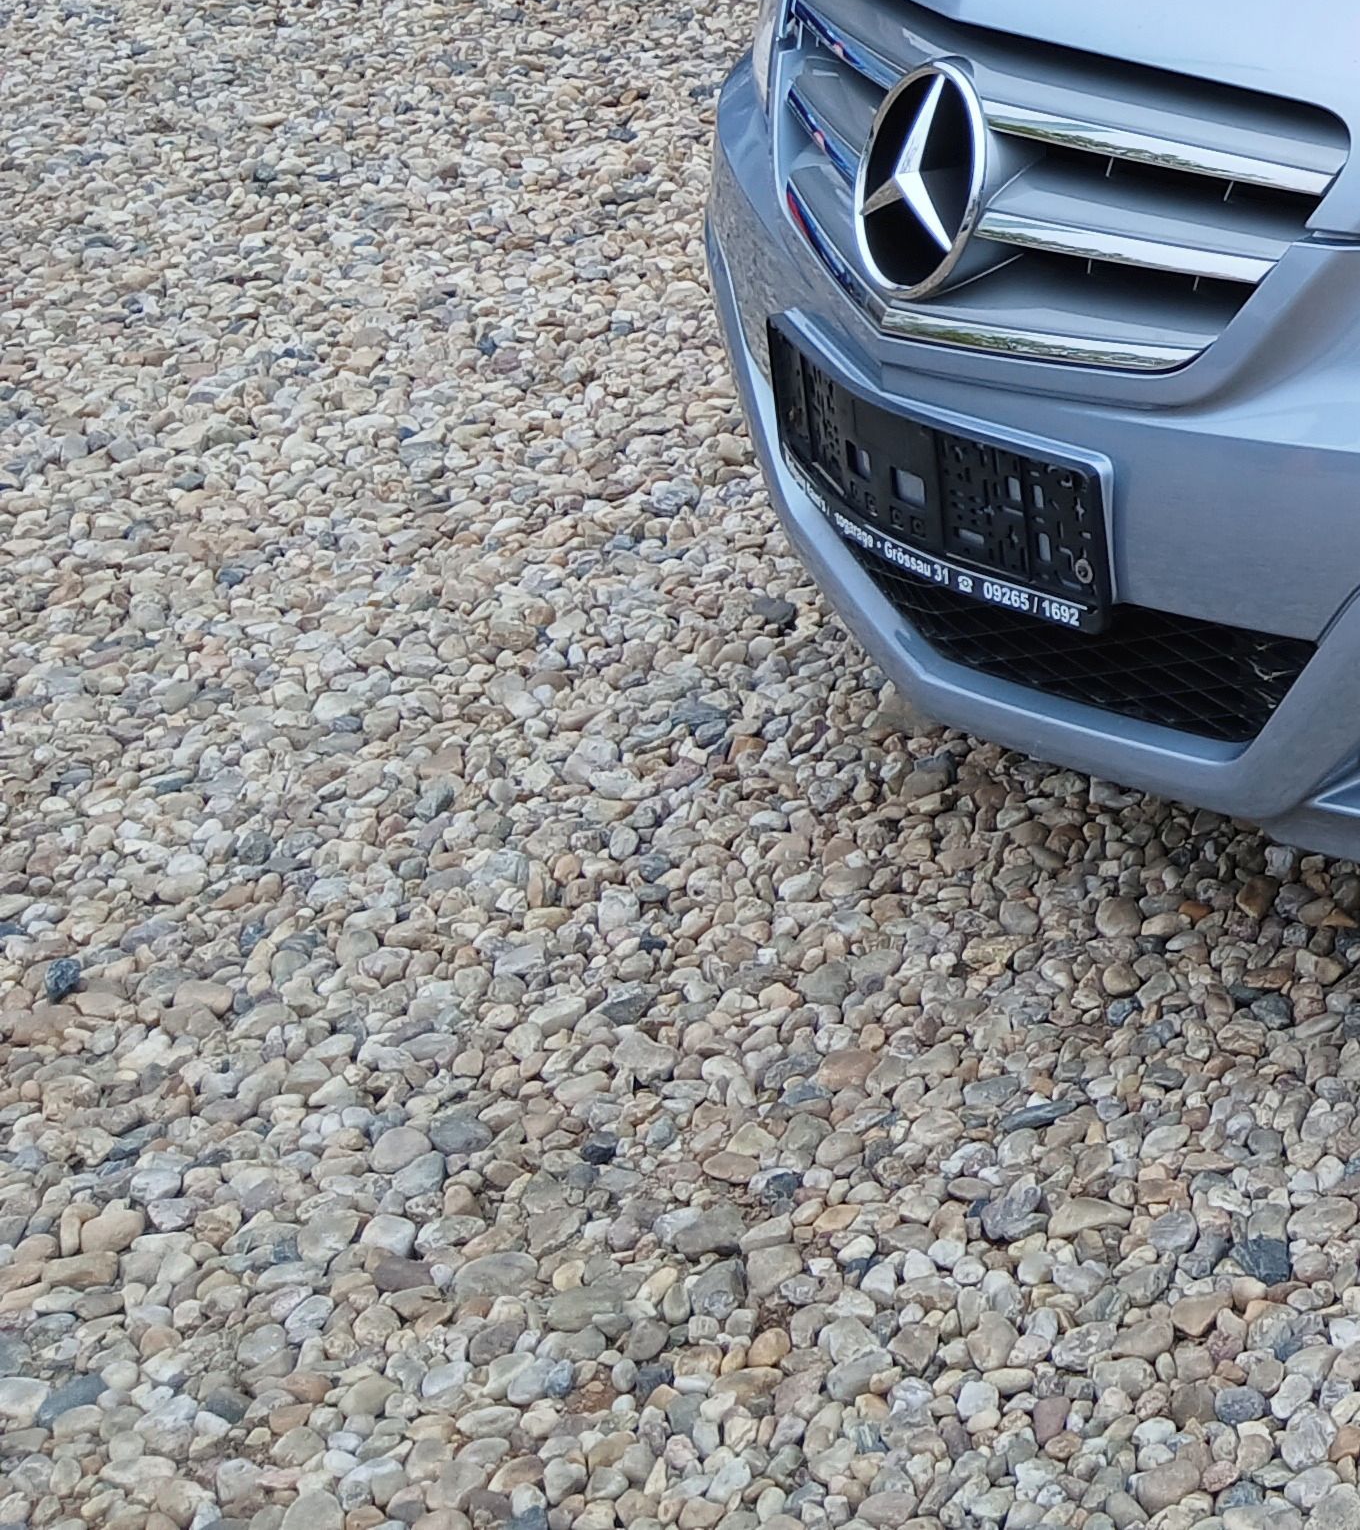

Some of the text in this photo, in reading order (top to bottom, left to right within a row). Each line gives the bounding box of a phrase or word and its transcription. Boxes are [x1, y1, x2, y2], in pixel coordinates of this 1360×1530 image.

[884, 541, 932, 578] Grössau
[934, 563, 949, 584] 31
[983, 581, 1030, 611] 09265
[1042, 600, 1080, 626] 1692
